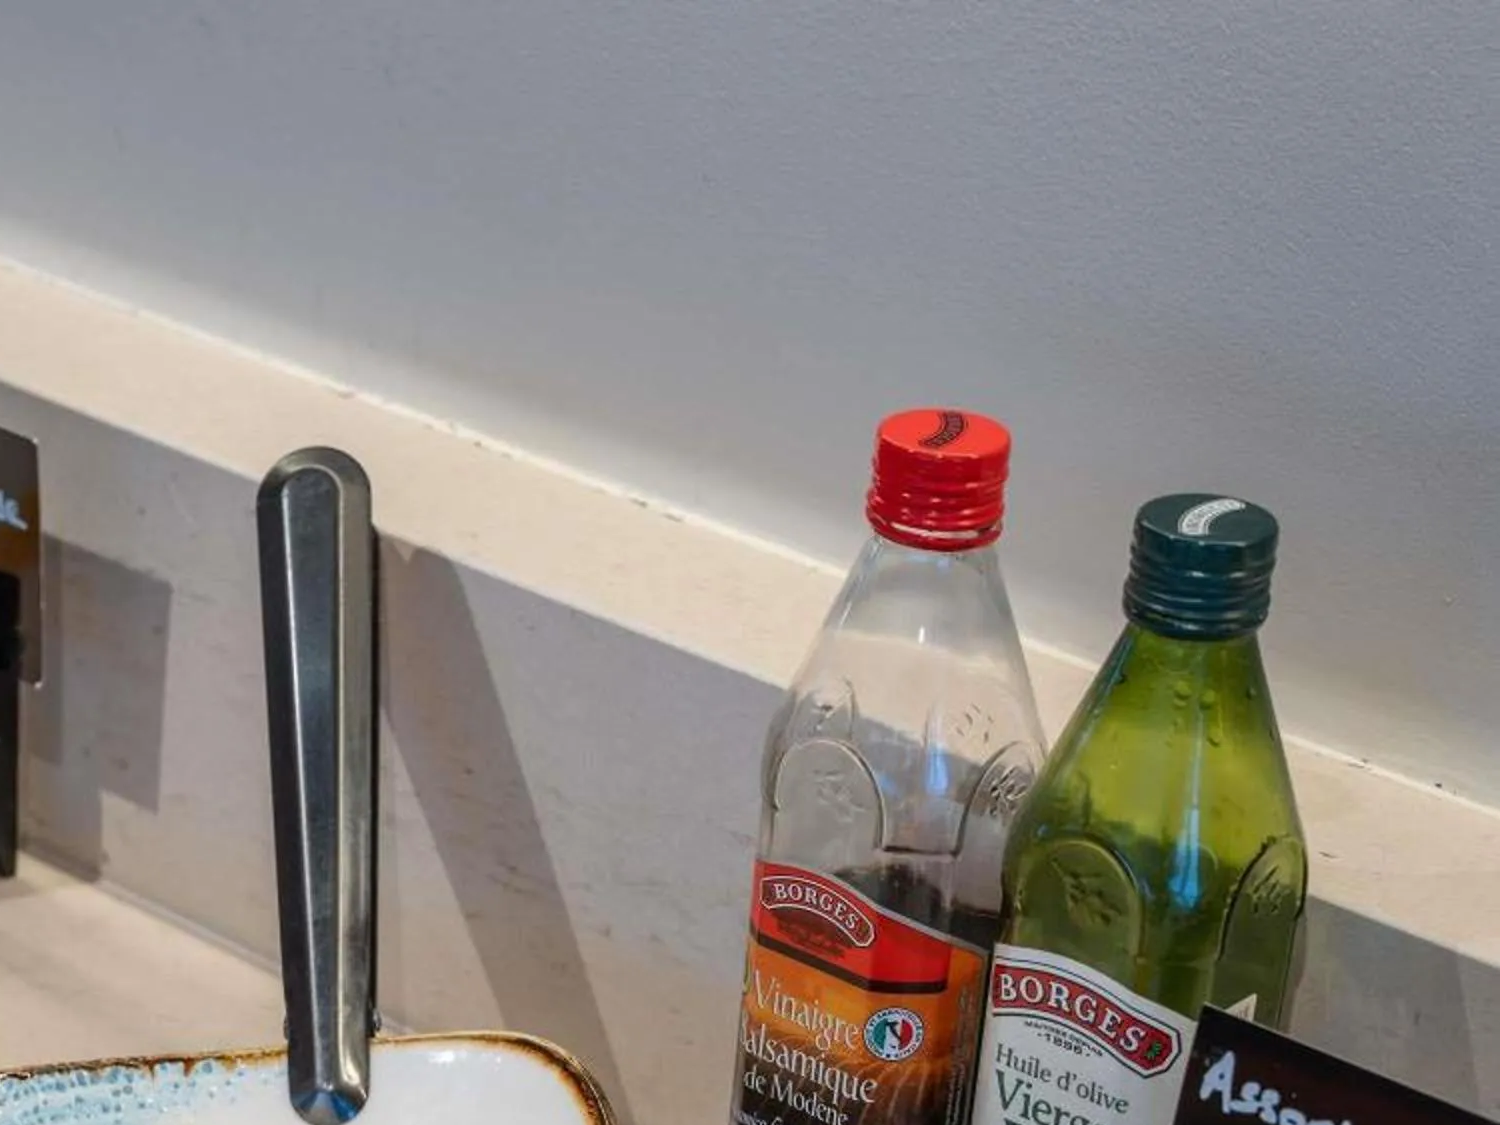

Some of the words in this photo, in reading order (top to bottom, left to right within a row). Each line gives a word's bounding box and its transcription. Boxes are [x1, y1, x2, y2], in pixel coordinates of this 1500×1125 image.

[773, 883, 860, 929] BORGES
[755, 969, 859, 1050] Vinaigre
[998, 973, 1148, 1053] BORGES
[744, 1064, 767, 1095] de
[995, 1043, 1052, 1083] Huile
[1057, 1071, 1130, 1115] d'olive
